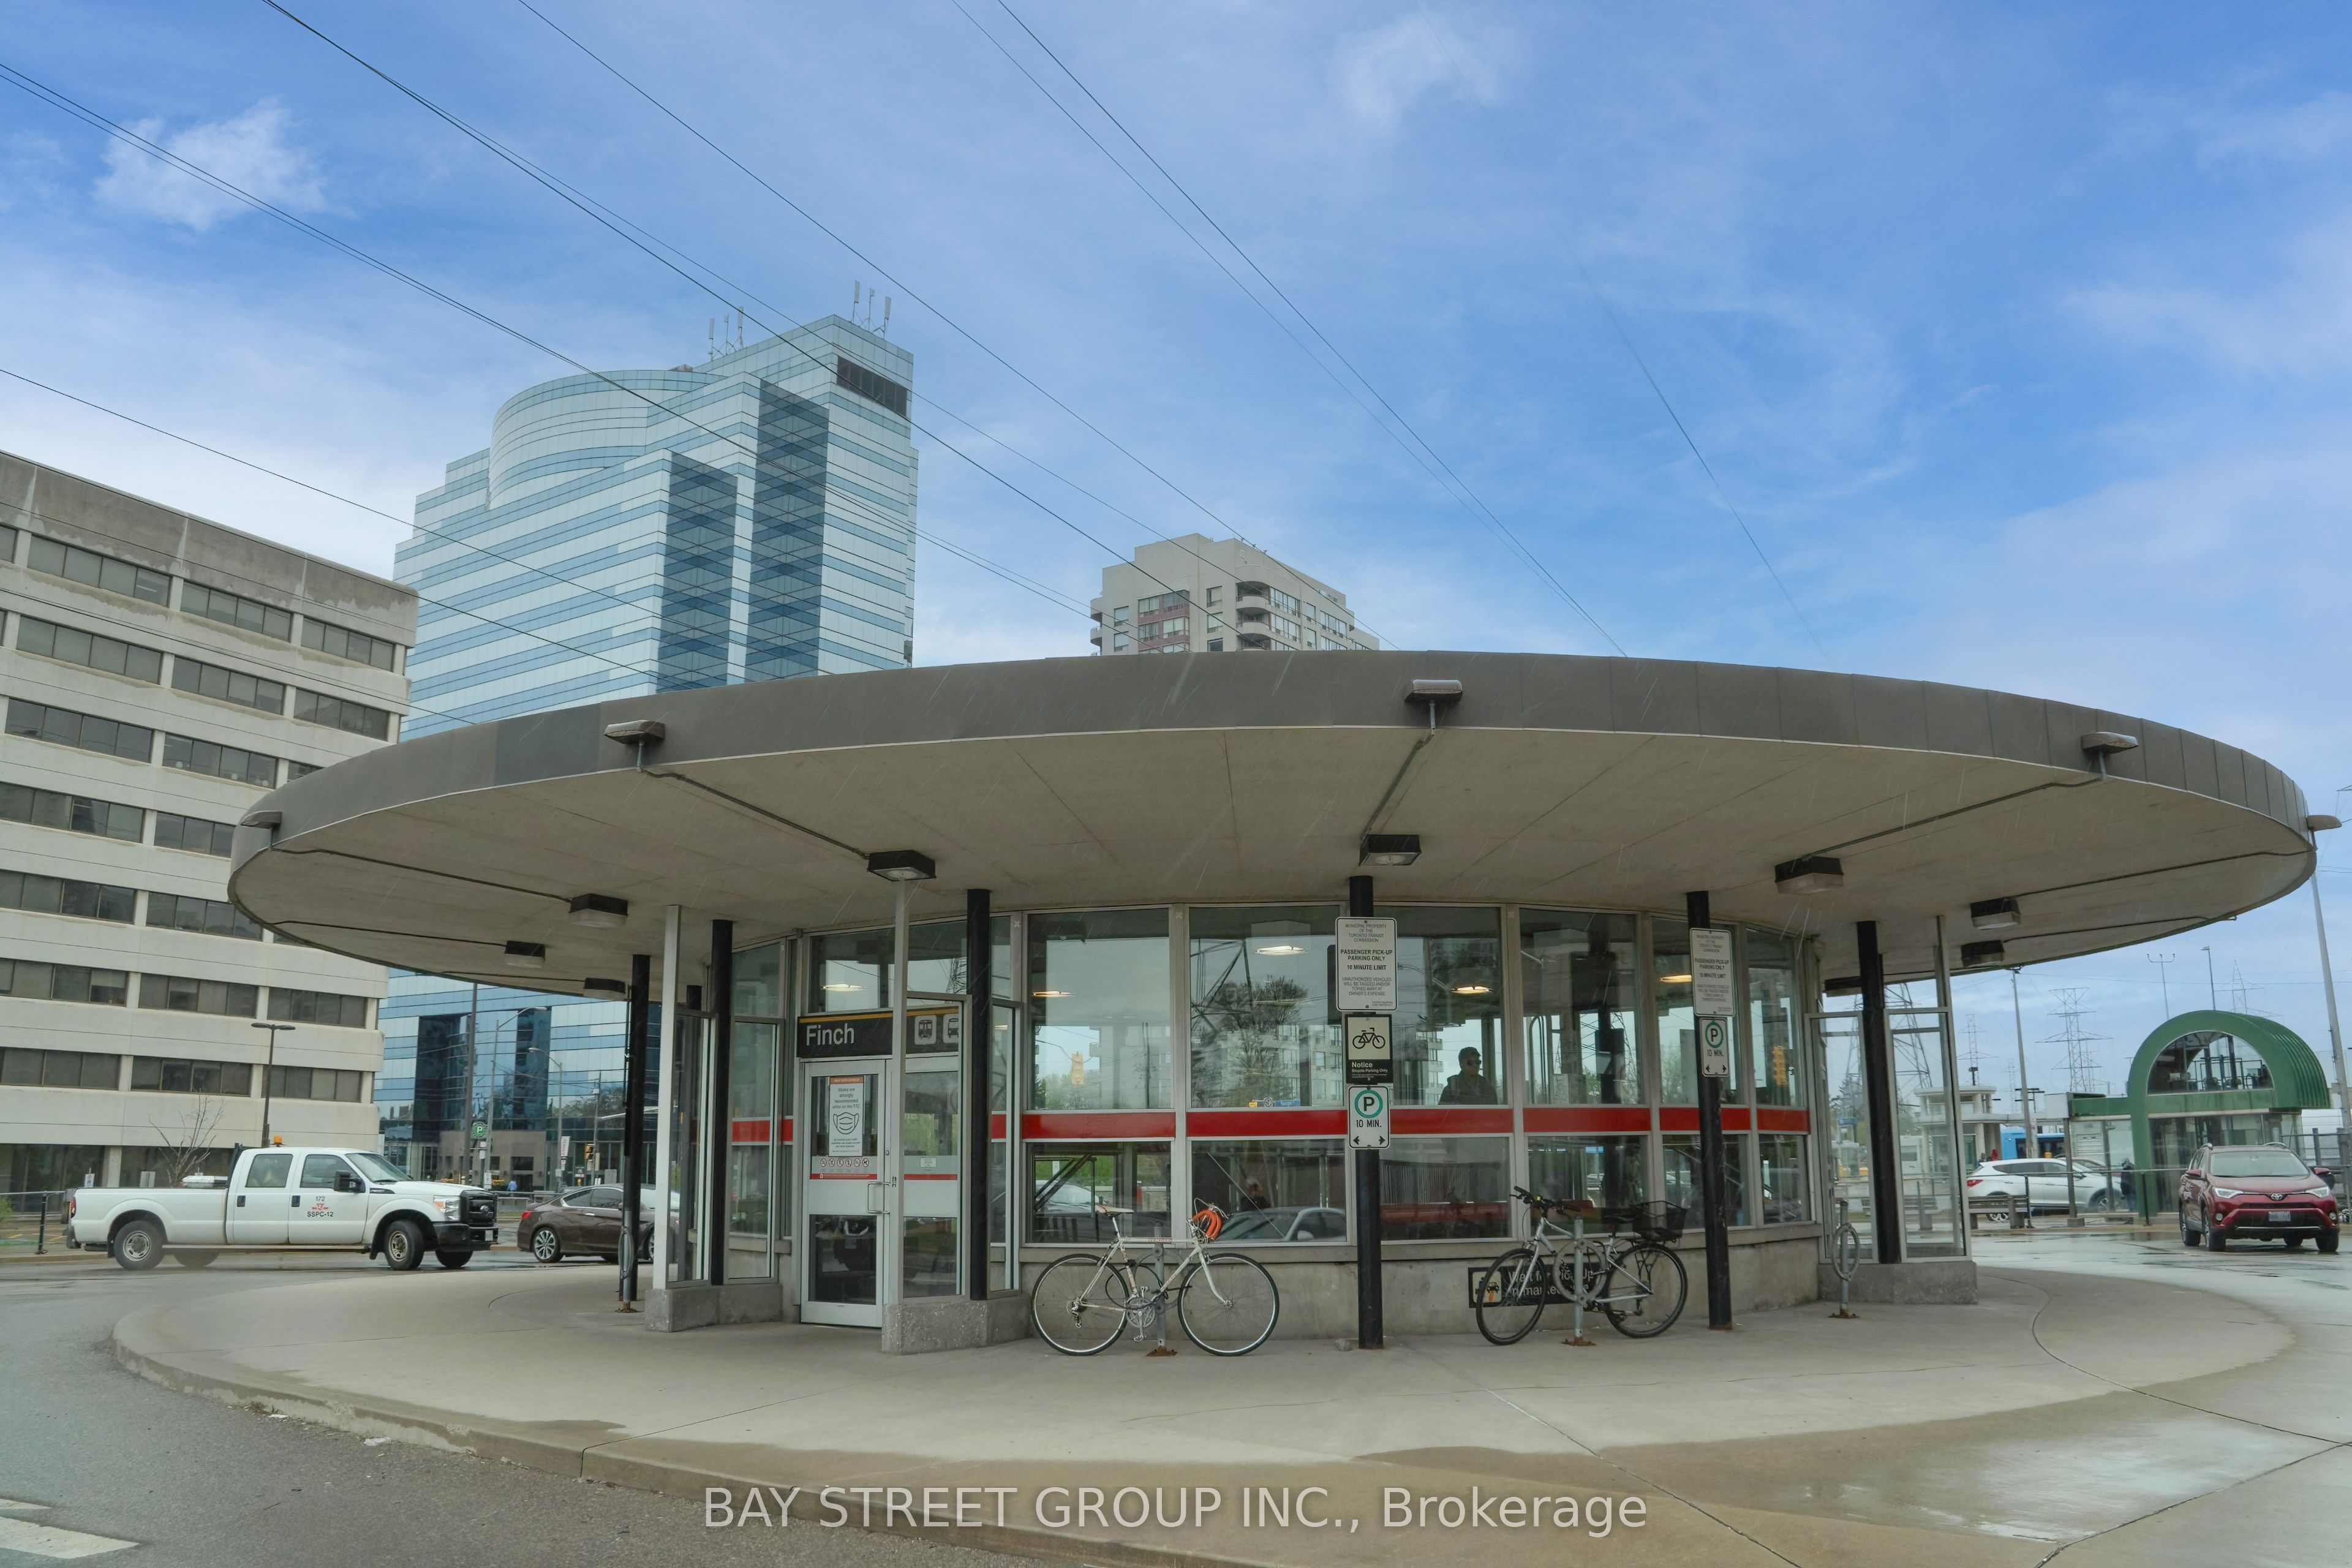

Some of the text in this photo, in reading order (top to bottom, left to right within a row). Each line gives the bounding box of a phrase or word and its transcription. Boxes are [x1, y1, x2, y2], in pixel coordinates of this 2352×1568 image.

[806, 1023, 854, 1046] Finch
[1711, 1028, 1718, 1042] P
[1363, 1096, 1375, 1112] P
[1356, 1119, 1382, 1128] 10 MIN.
